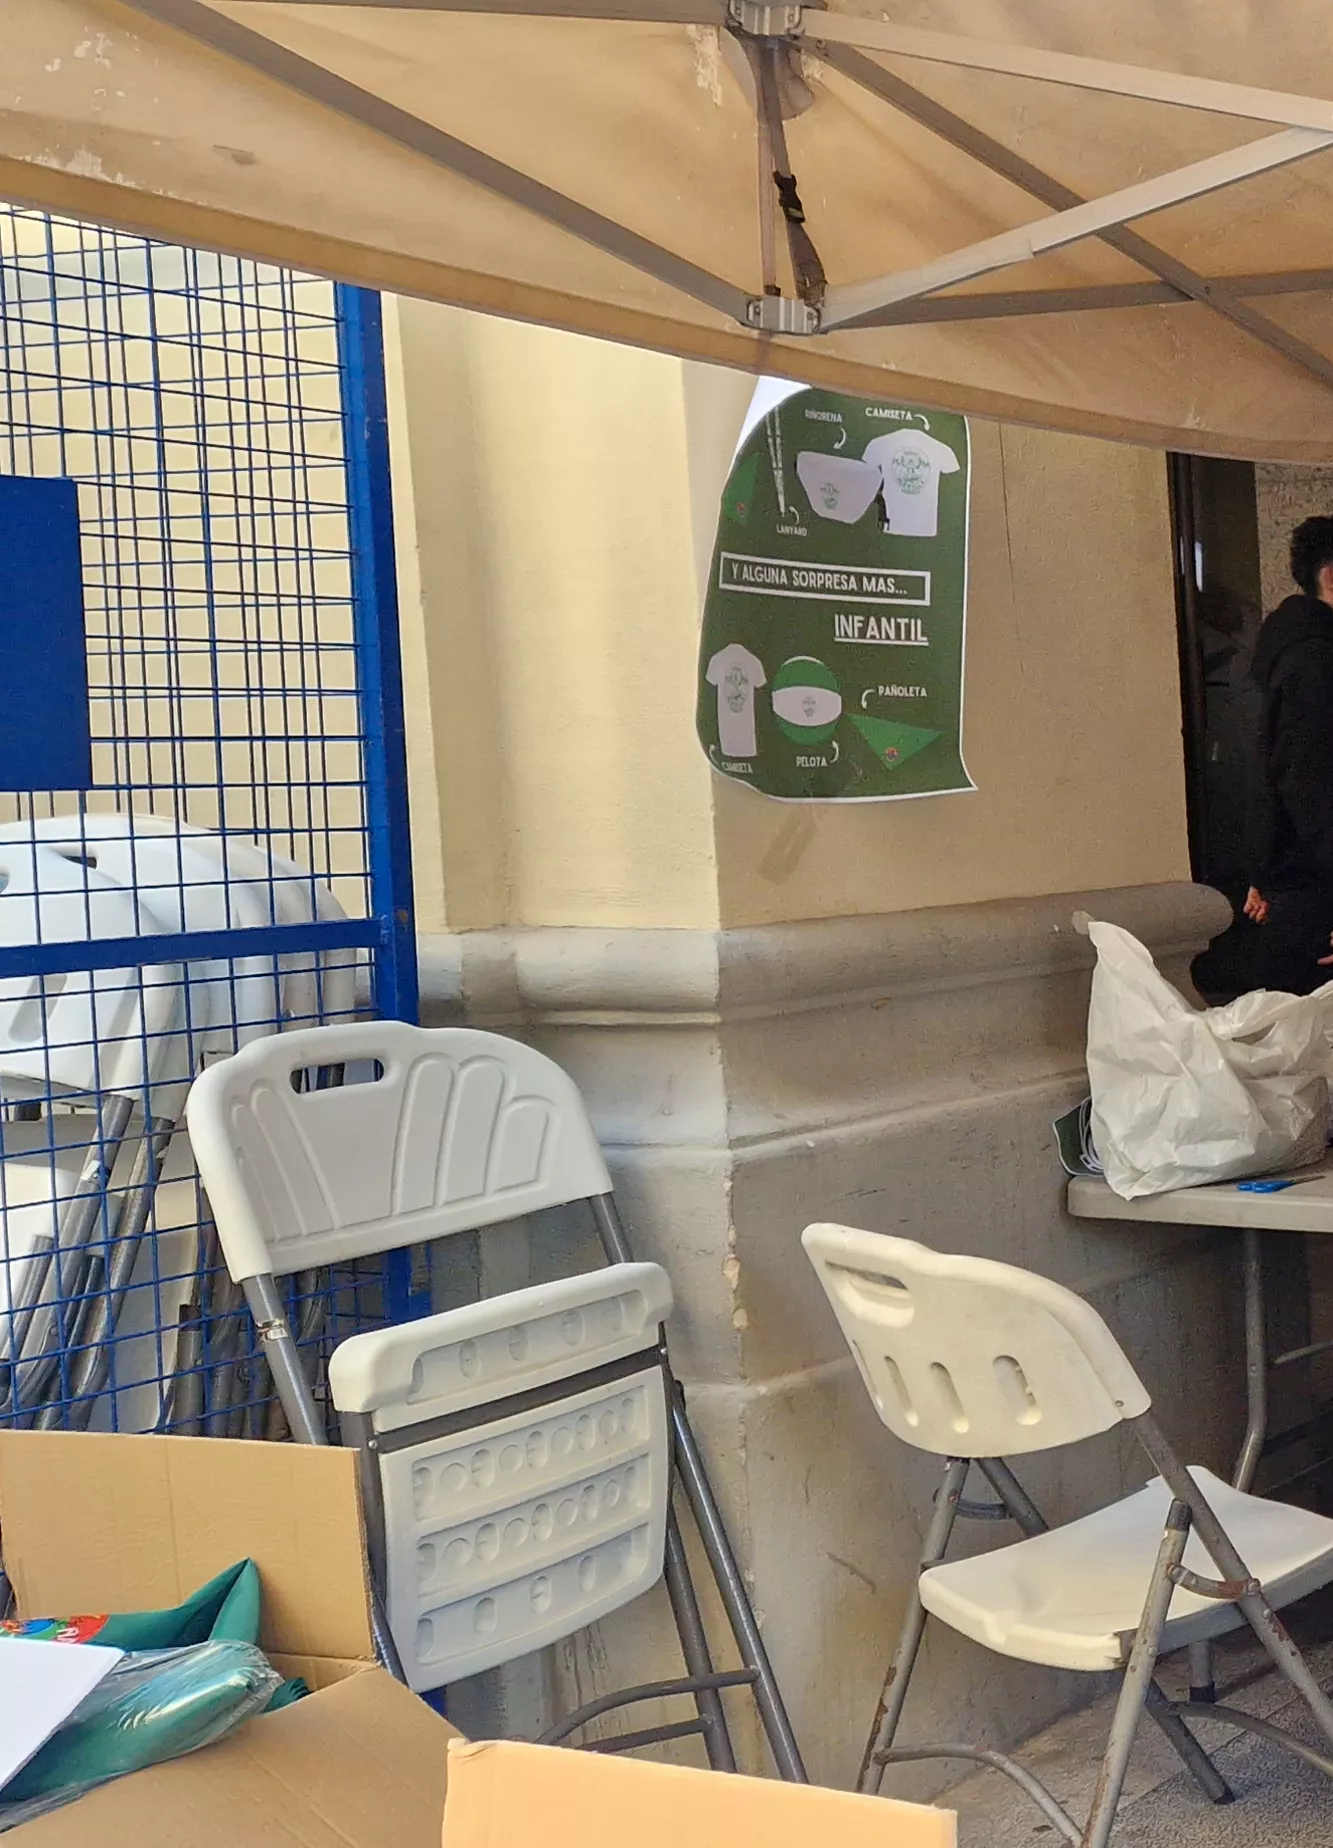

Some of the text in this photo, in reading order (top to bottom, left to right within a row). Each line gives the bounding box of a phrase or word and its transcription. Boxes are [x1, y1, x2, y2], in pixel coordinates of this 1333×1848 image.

[865, 407, 913, 421] CAMISETA
[731, 563, 908, 595] Y ALGUNA SORPRESA MAS...
[834, 614, 928, 642] INFANTIL
[878, 685, 927, 697] PAÑOLETA
[796, 756, 828, 768] PELOTA
